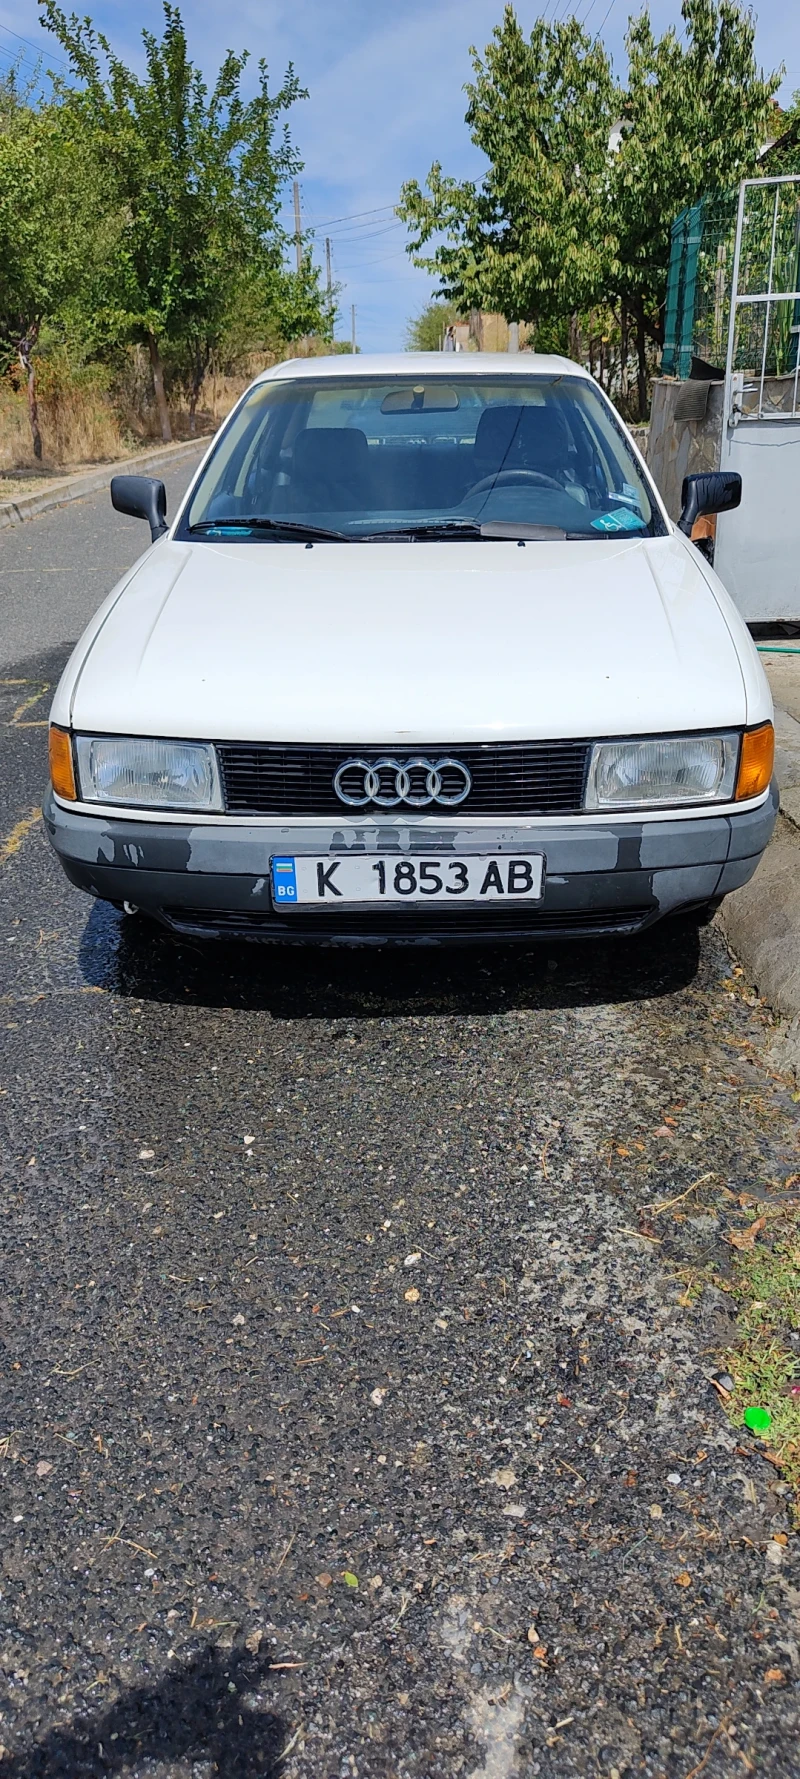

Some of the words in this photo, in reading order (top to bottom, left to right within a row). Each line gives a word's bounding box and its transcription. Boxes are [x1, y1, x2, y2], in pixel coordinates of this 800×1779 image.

[317, 862, 343, 896] K
[372, 860, 469, 895] 1853
[479, 860, 534, 895] AB
[277, 885, 295, 896] BG
